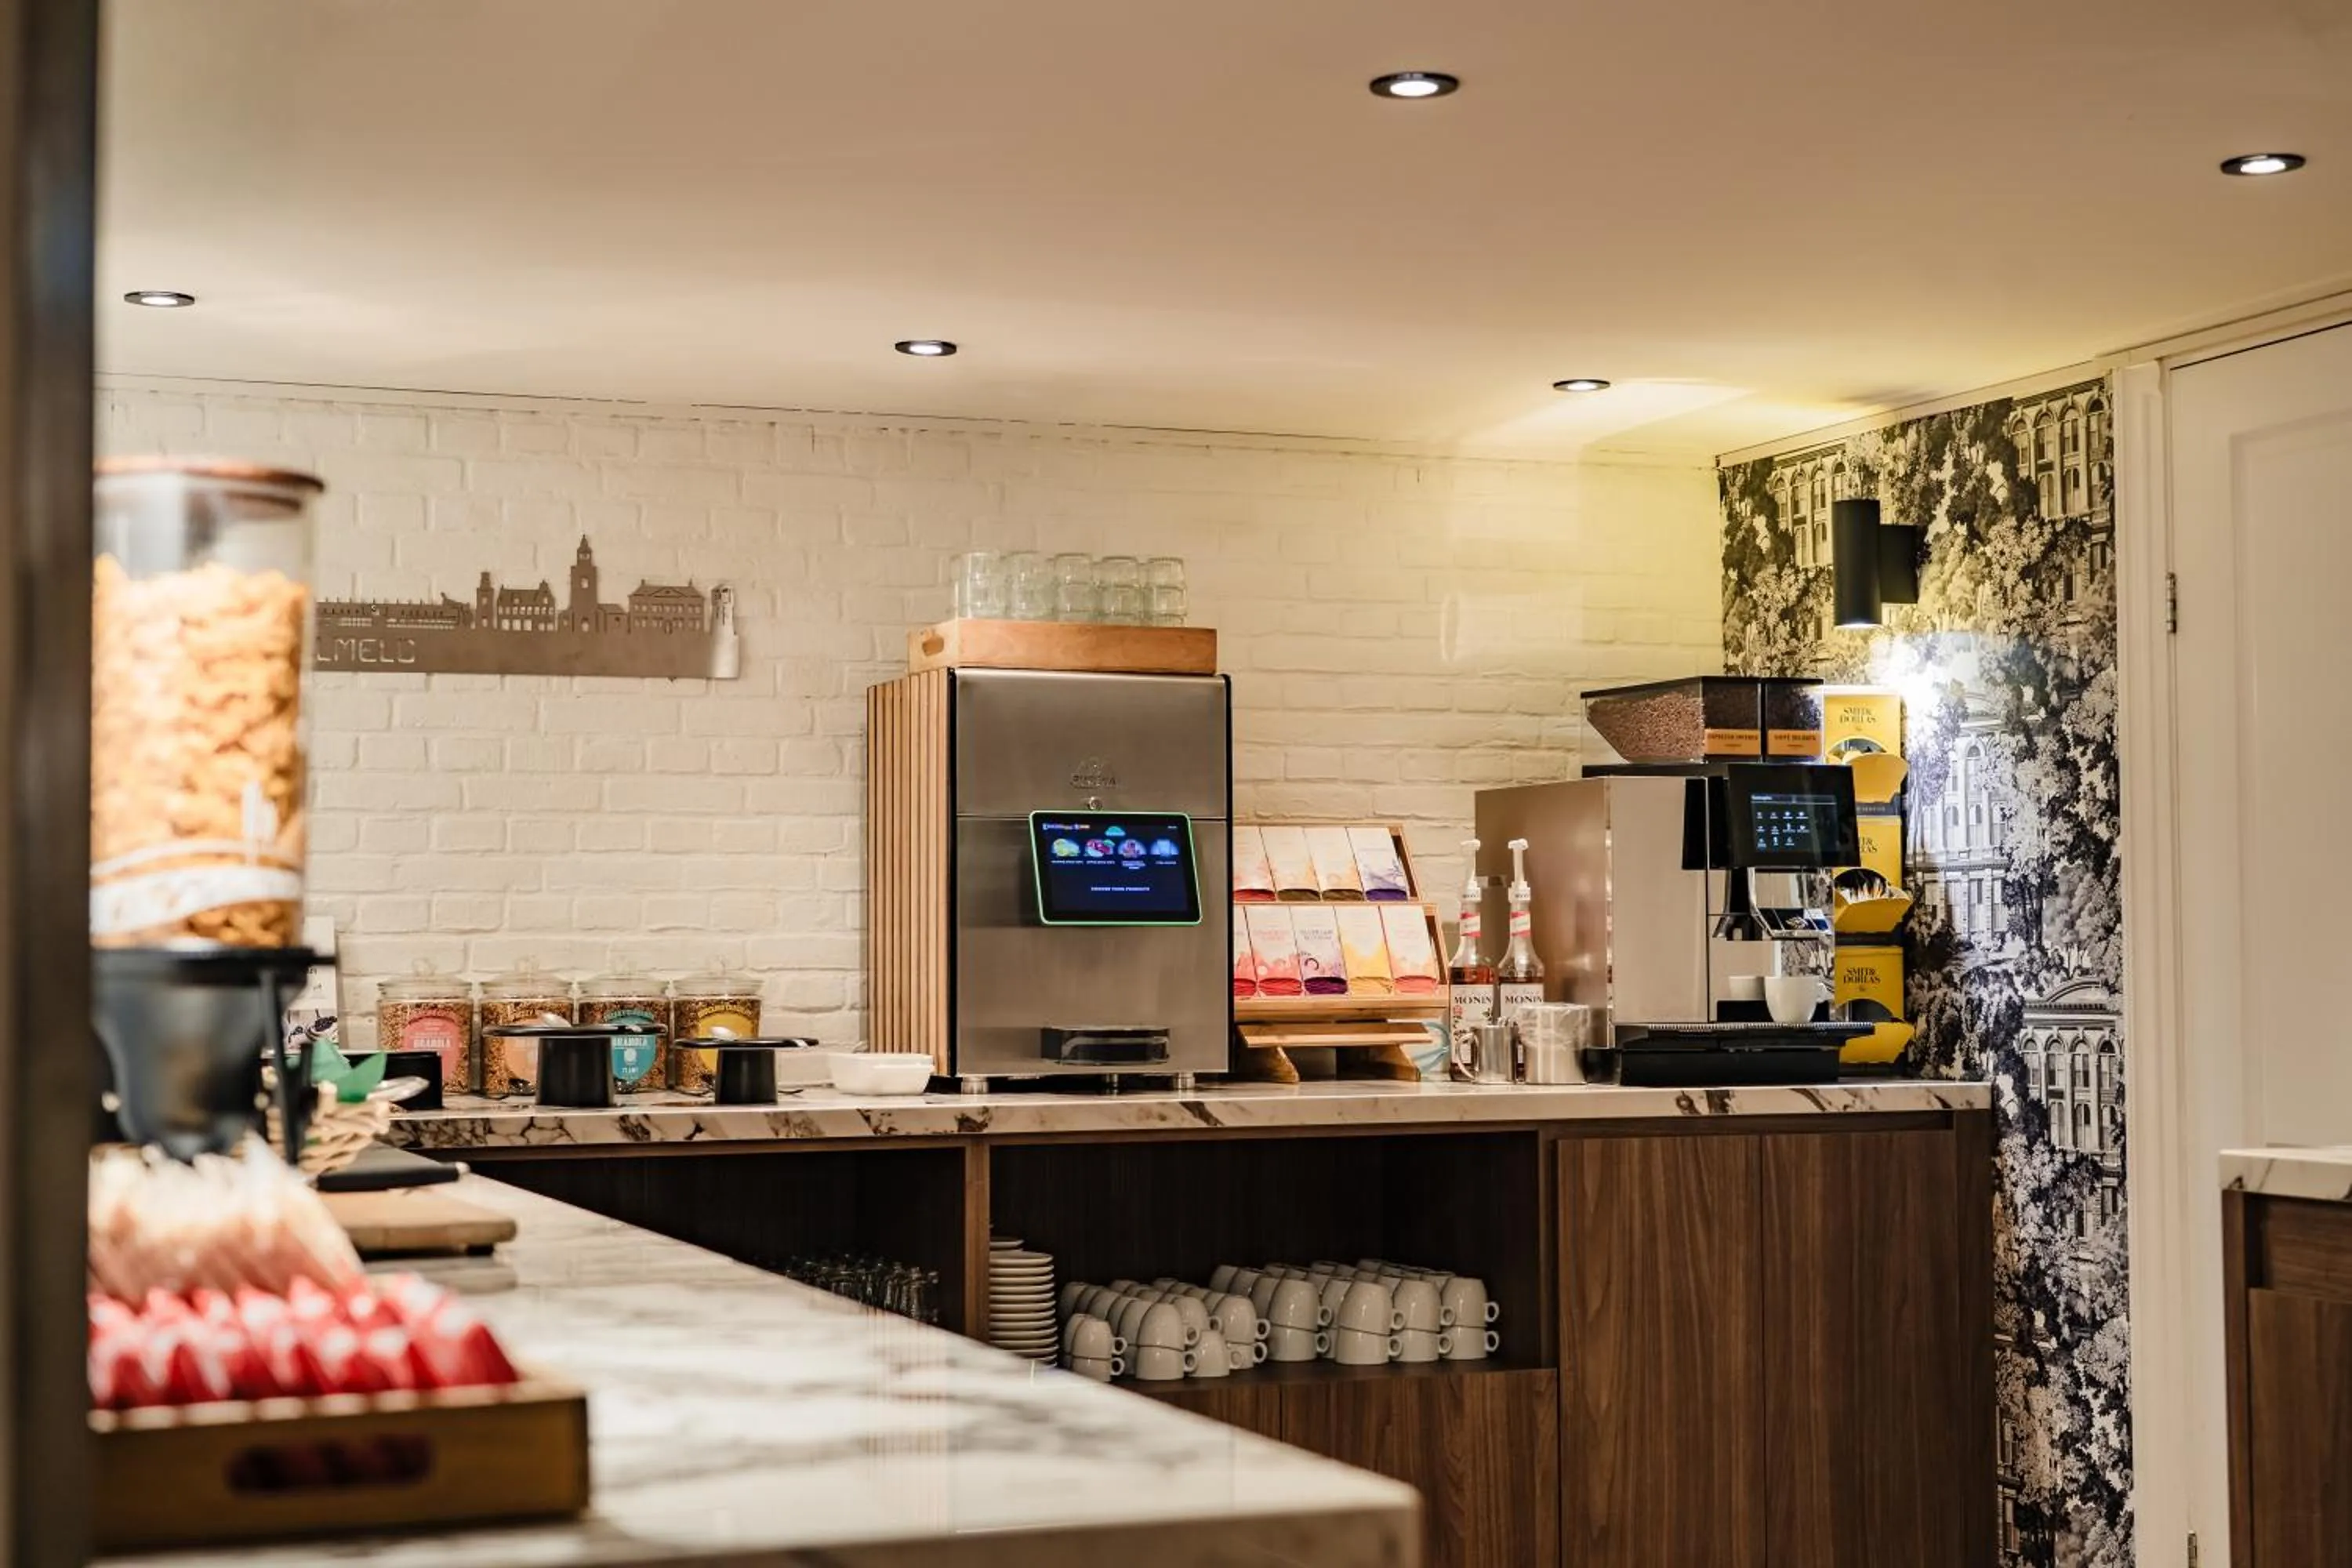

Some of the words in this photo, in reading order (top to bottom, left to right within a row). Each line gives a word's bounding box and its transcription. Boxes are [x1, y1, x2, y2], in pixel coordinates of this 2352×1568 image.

[315, 637, 416, 663] LMELO
[1454, 996, 1493, 1004] MONIN
[1505, 995, 1543, 1004] MONIN
